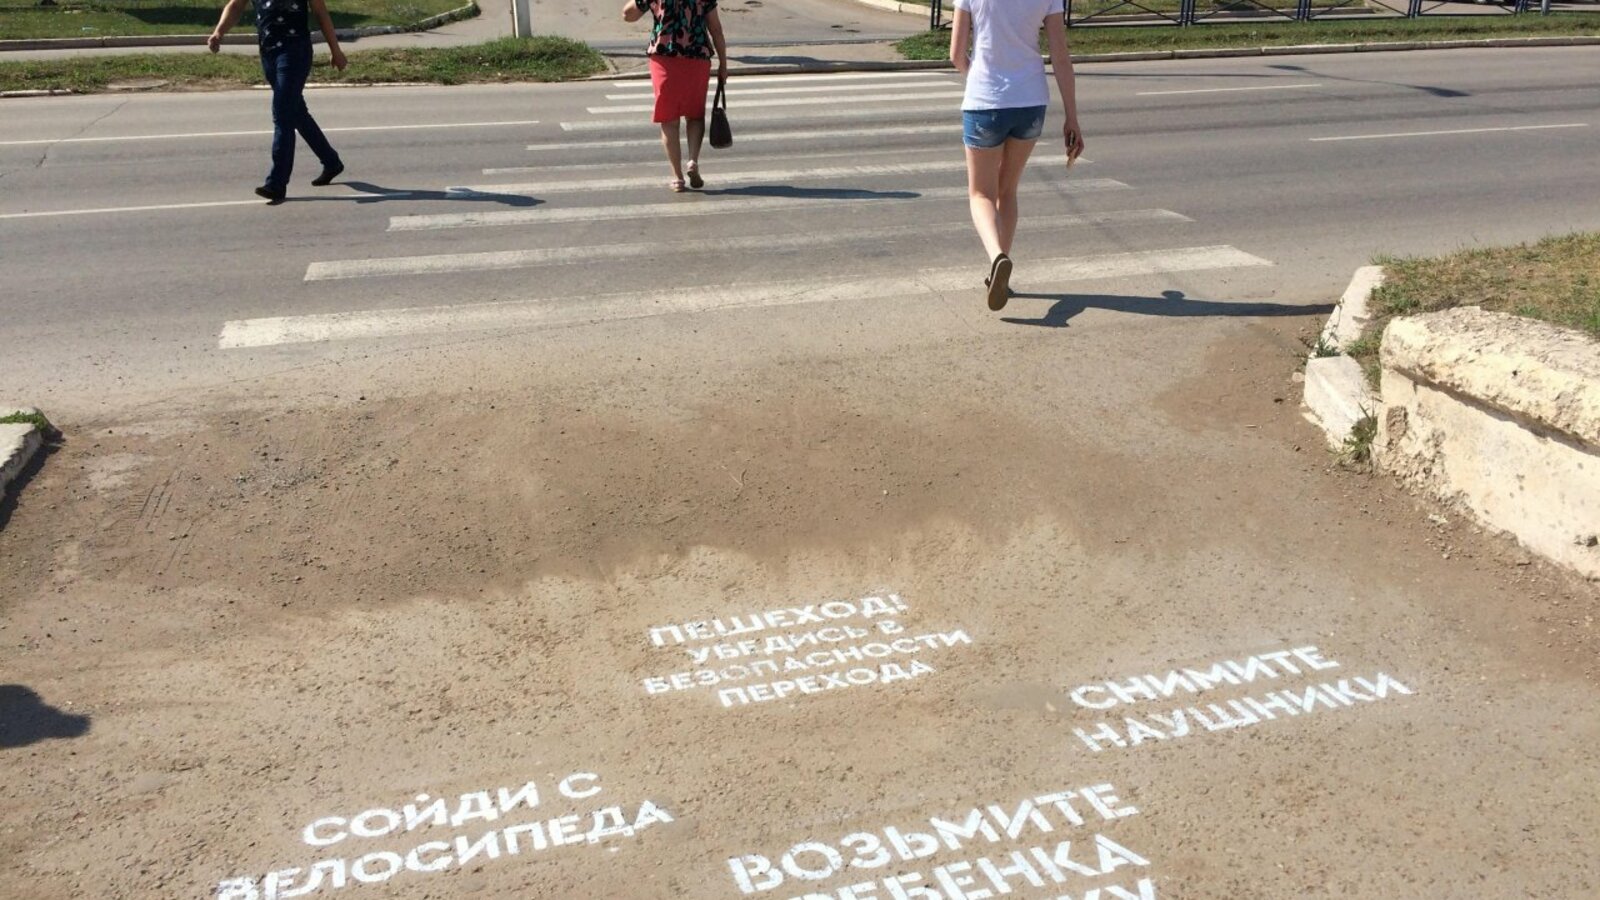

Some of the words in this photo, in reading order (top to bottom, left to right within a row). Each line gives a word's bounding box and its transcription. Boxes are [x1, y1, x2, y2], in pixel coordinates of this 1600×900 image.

[649, 593, 909, 647] ПЕШЕХОД!
[686, 626, 868, 664] УБЕДИСЬ
[878, 620, 904, 635] В
[643, 629, 972, 695] БЕЗОПАСНОСТИ
[717, 659, 936, 708] ПЕРЕХОДА
[1069, 645, 1340, 709] СНИМИТЕ
[1073, 672, 1413, 751] НАУШНИКИ
[302, 780, 539, 846] СОЙДИ
[558, 772, 602, 799] С
[727, 782, 1139, 894] ВОЗЬМИТЕ
[216, 800, 675, 900] ВЕЛОСИПЕДА
[786, 833, 1151, 900] БЕНКА
